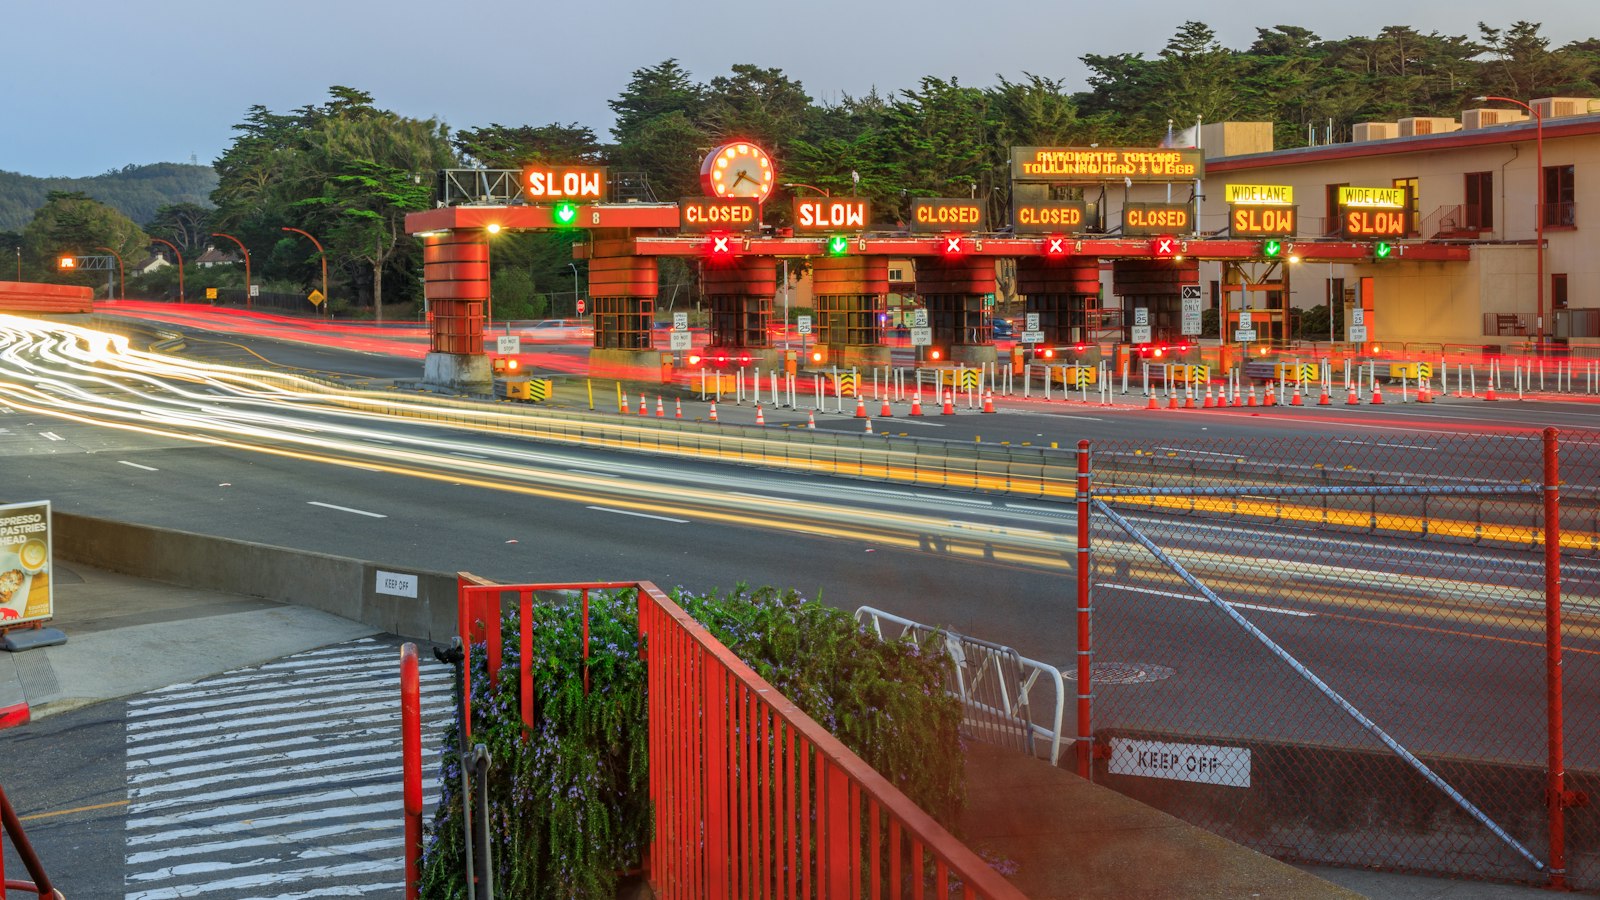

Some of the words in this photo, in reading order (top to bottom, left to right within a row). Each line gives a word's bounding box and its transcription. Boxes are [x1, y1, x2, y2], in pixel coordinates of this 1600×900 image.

[529, 171, 600, 196] SLOW
[1231, 185, 1257, 201] WIDE
[1259, 186, 1287, 201] LANE
[1345, 188, 1370, 204] WIDE
[1372, 189, 1399, 204] LANE
[592, 211, 600, 225] 8
[686, 205, 753, 222] CLOSED
[800, 203, 864, 226] SLOW
[917, 206, 980, 223] CLOSED
[1019, 208, 1080, 224] CLOSED
[1128, 210, 1187, 227] CLOSED
[1235, 209, 1292, 232] SLOW
[1348, 211, 1404, 234] SLOW
[743, 238, 751, 250] 7
[859, 239, 866, 250] 6
[975, 240, 983, 251] 5
[1075, 240, 1082, 252] 4
[1181, 241, 1188, 252] 3
[1287, 243, 1294, 254] 2
[1399, 245, 1404, 256] 1
[675, 321, 687, 330] 25
[915, 318, 927, 326] 25
[1028, 322, 1038, 330] 25
[1136, 316, 1147, 324] 25
[1240, 321, 1251, 329] 25
[1354, 316, 1363, 324] 25
[799, 325, 811, 333] 25
[0, 522, 47, 537] PASTRIES
[0, 534, 27, 547] HEAD
[384, 578, 398, 590] KEEP
[398, 580, 409, 591] OFF
[1138, 751, 1179, 770] KEEP
[1186, 754, 1218, 773] OFF
